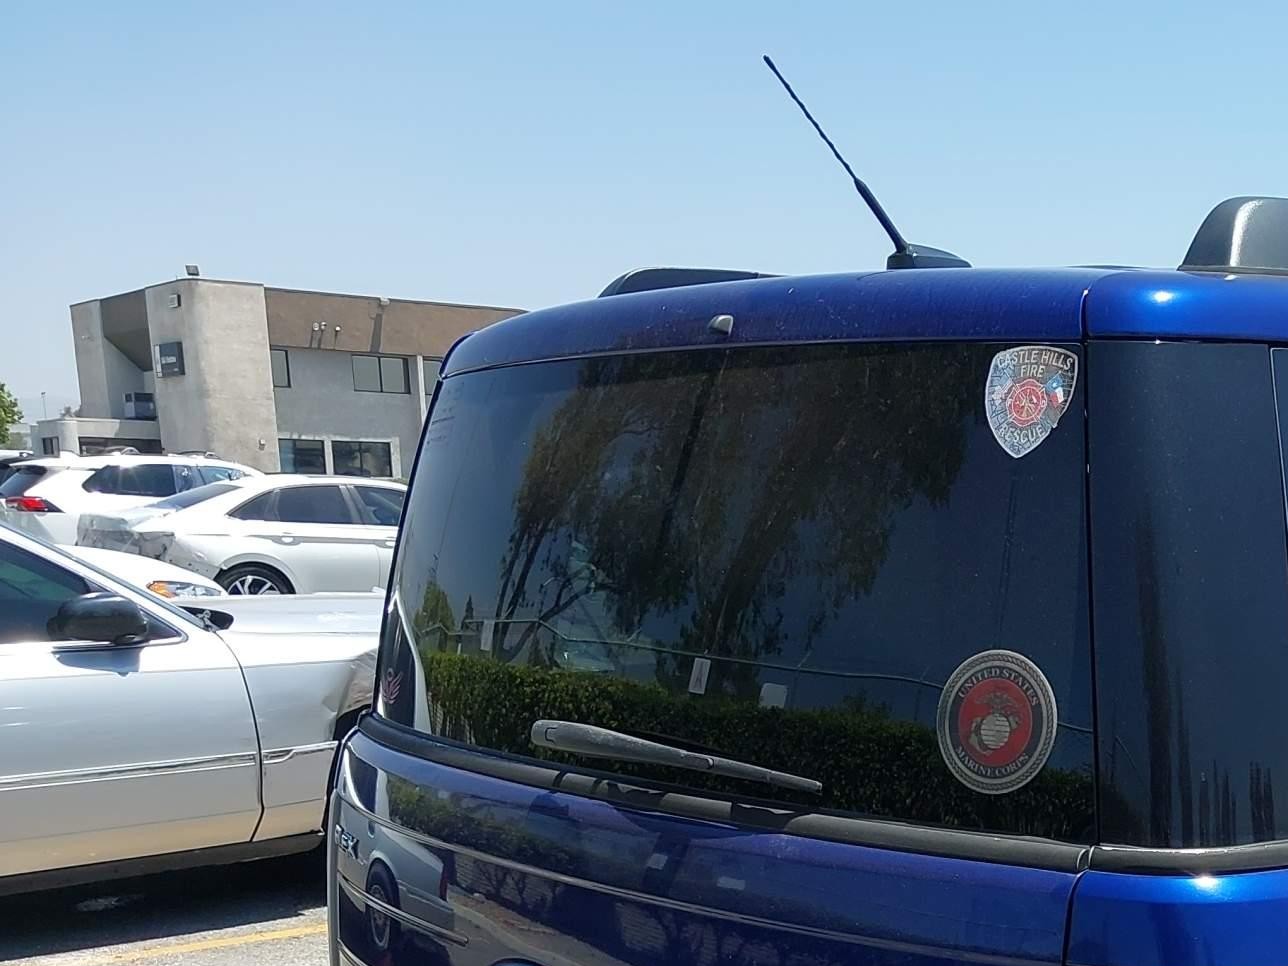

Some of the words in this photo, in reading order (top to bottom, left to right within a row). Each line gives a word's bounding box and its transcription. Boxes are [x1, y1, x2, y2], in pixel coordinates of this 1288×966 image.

[997, 351, 1039, 368] CASTLE
[1041, 351, 1073, 370] HILLS
[1020, 364, 1046, 378] FIRE
[999, 422, 1045, 444] RESCUE
[957, 667, 1000, 699] UNITED
[1001, 670, 1039, 706] STATES
[956, 746, 994, 776] MARINE
[995, 752, 1030, 776] CORPS
